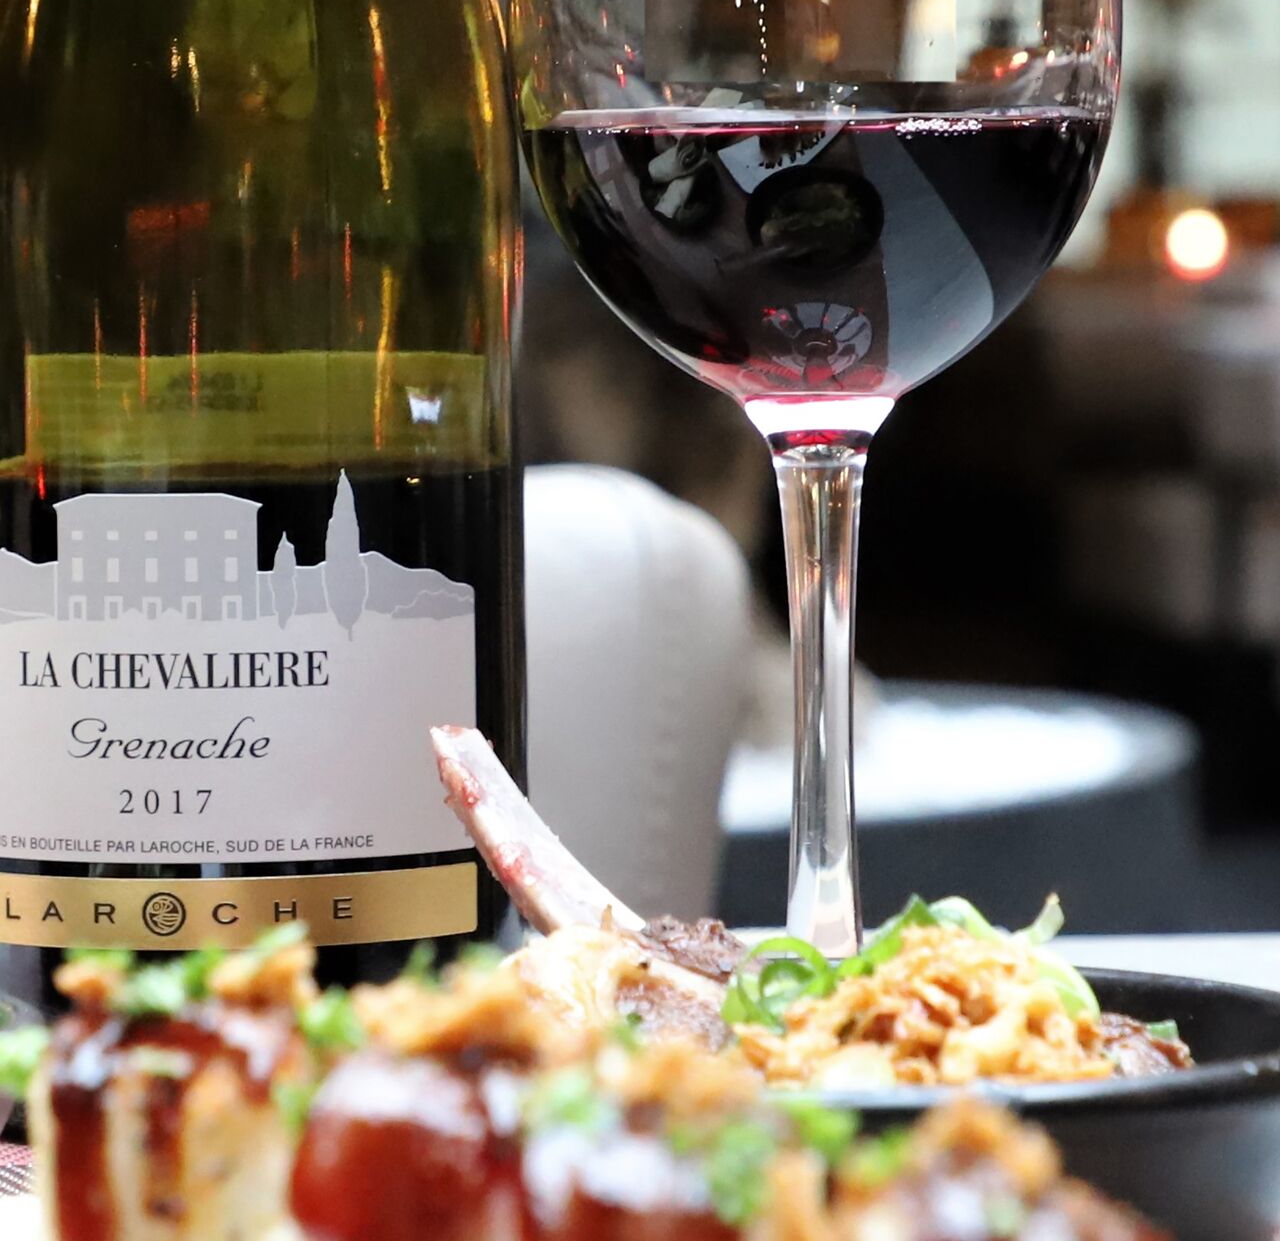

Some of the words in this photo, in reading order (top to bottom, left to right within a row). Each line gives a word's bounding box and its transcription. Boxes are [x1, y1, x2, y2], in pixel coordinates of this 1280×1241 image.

[19, 650, 62, 688] LA
[71, 649, 330, 690] CHEVALIERE
[66, 716, 271, 760] Grenache
[118, 789, 213, 815] 2017
[11, 835, 27, 849] EN
[30, 837, 102, 853] BOUTEILLE
[106, 840, 135, 853] PAR
[140, 840, 220, 854] LAROCHE,
[225, 839, 259, 853] SUD
[264, 838, 286, 852] DE
[290, 838, 310, 851] LA
[314, 834, 375, 850] FRANCE
